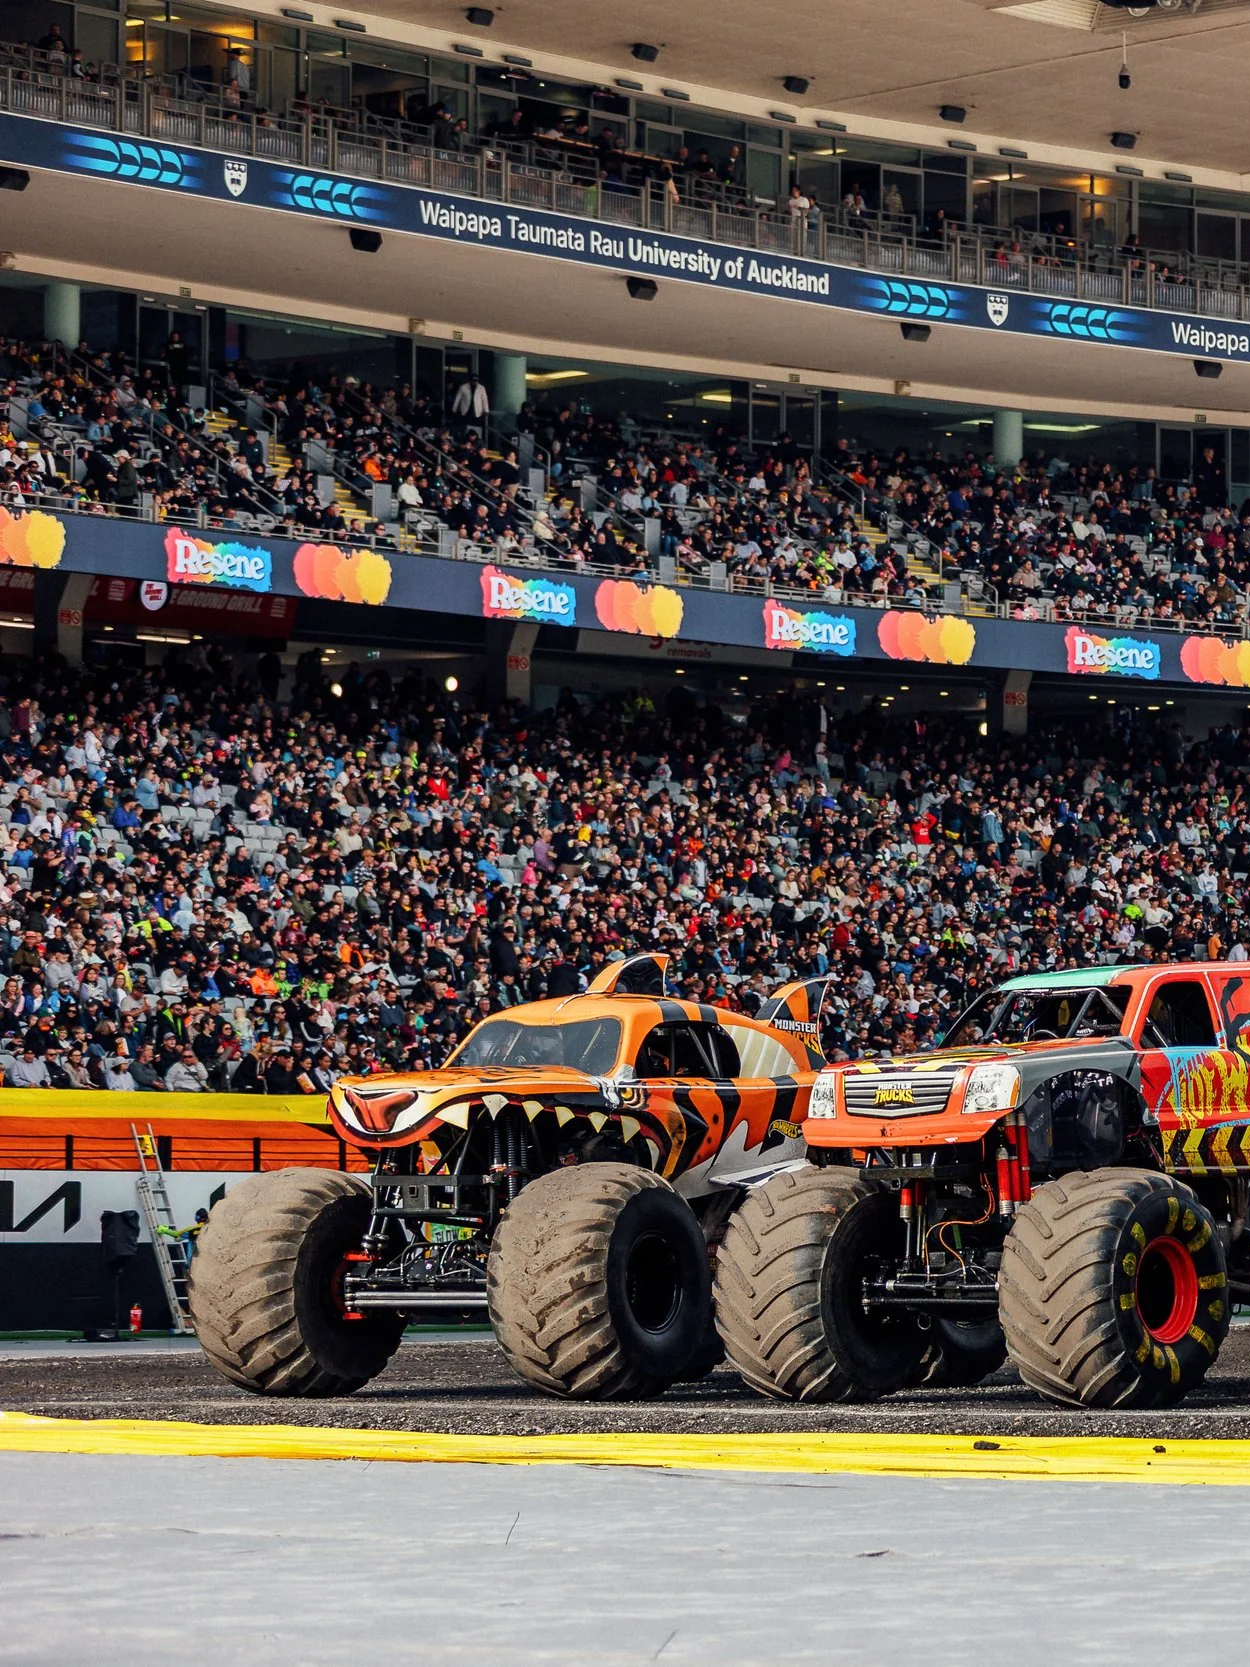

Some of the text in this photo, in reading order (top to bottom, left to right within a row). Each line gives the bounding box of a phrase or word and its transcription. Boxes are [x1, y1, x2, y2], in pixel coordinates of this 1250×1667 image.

[419, 200, 830, 296] Waipapa Taumata Rau University of Auckland
[1171, 322, 1249, 356] Waipapa
[174, 540, 265, 580] Resene
[489, 577, 570, 616] Resene
[771, 608, 850, 646] Resene
[1074, 636, 1155, 669] Resene
[774, 1018, 817, 1034] MONSTER
[874, 1089, 915, 1105] TRUCKS
